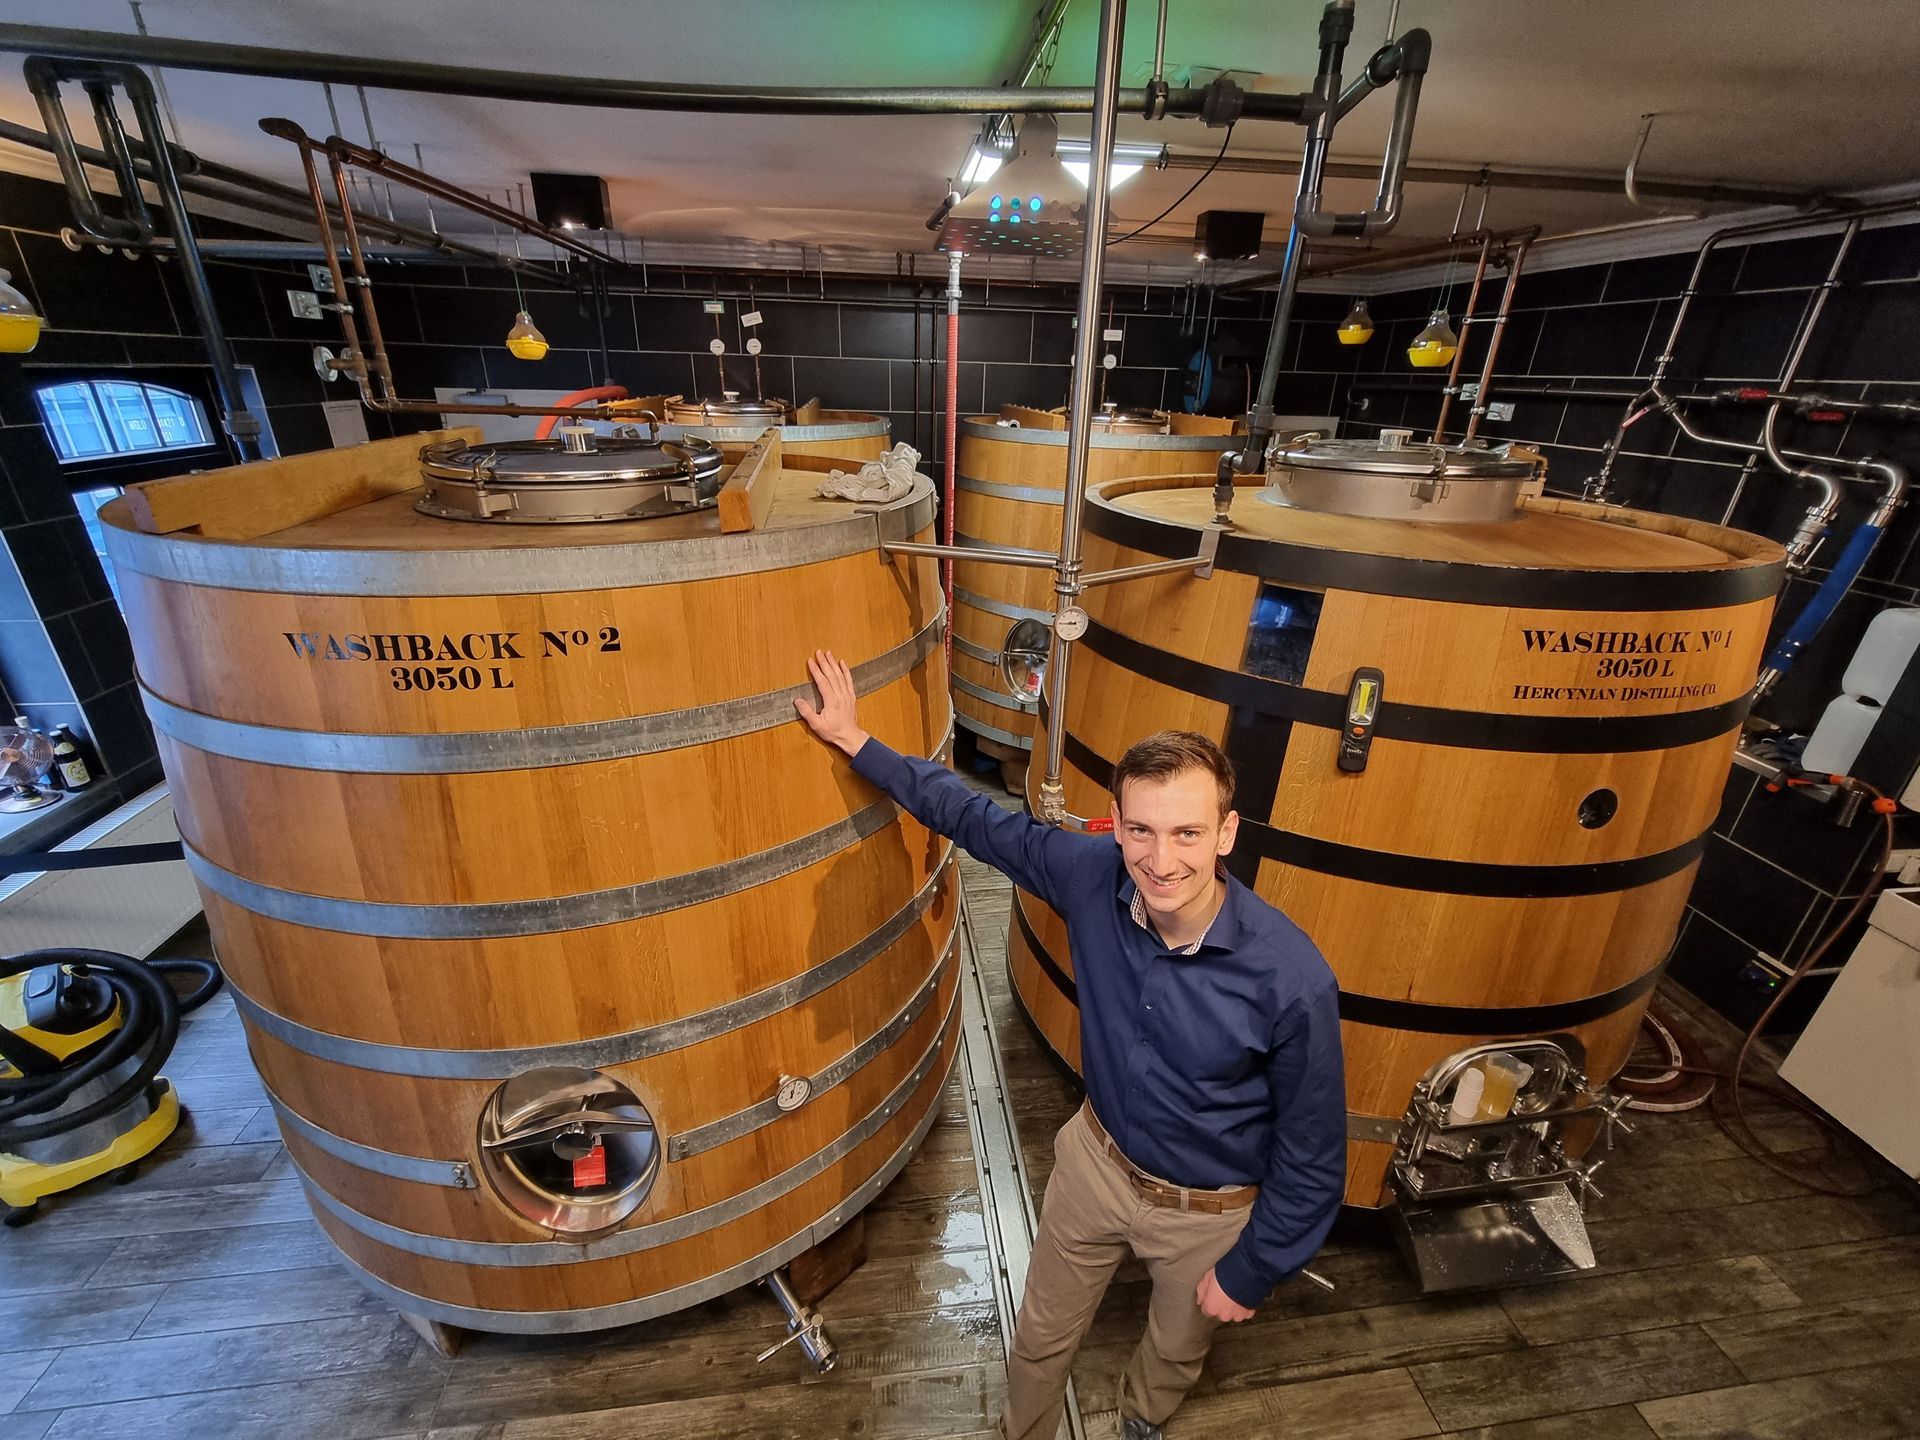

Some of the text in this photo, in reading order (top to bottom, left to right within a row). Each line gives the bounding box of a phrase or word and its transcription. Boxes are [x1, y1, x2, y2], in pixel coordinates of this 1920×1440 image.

[282, 632, 526, 662] WASHBACK
[599, 626, 622, 653] 2
[1521, 629, 1691, 654] WASHBACK
[1723, 629, 1734, 649] 1
[390, 665, 515, 692] 3050 L
[1596, 657, 1674, 679] 3050 L
[1512, 684, 1618, 701] HERCYNIAN
[1620, 685, 1700, 701] DISTILLING
